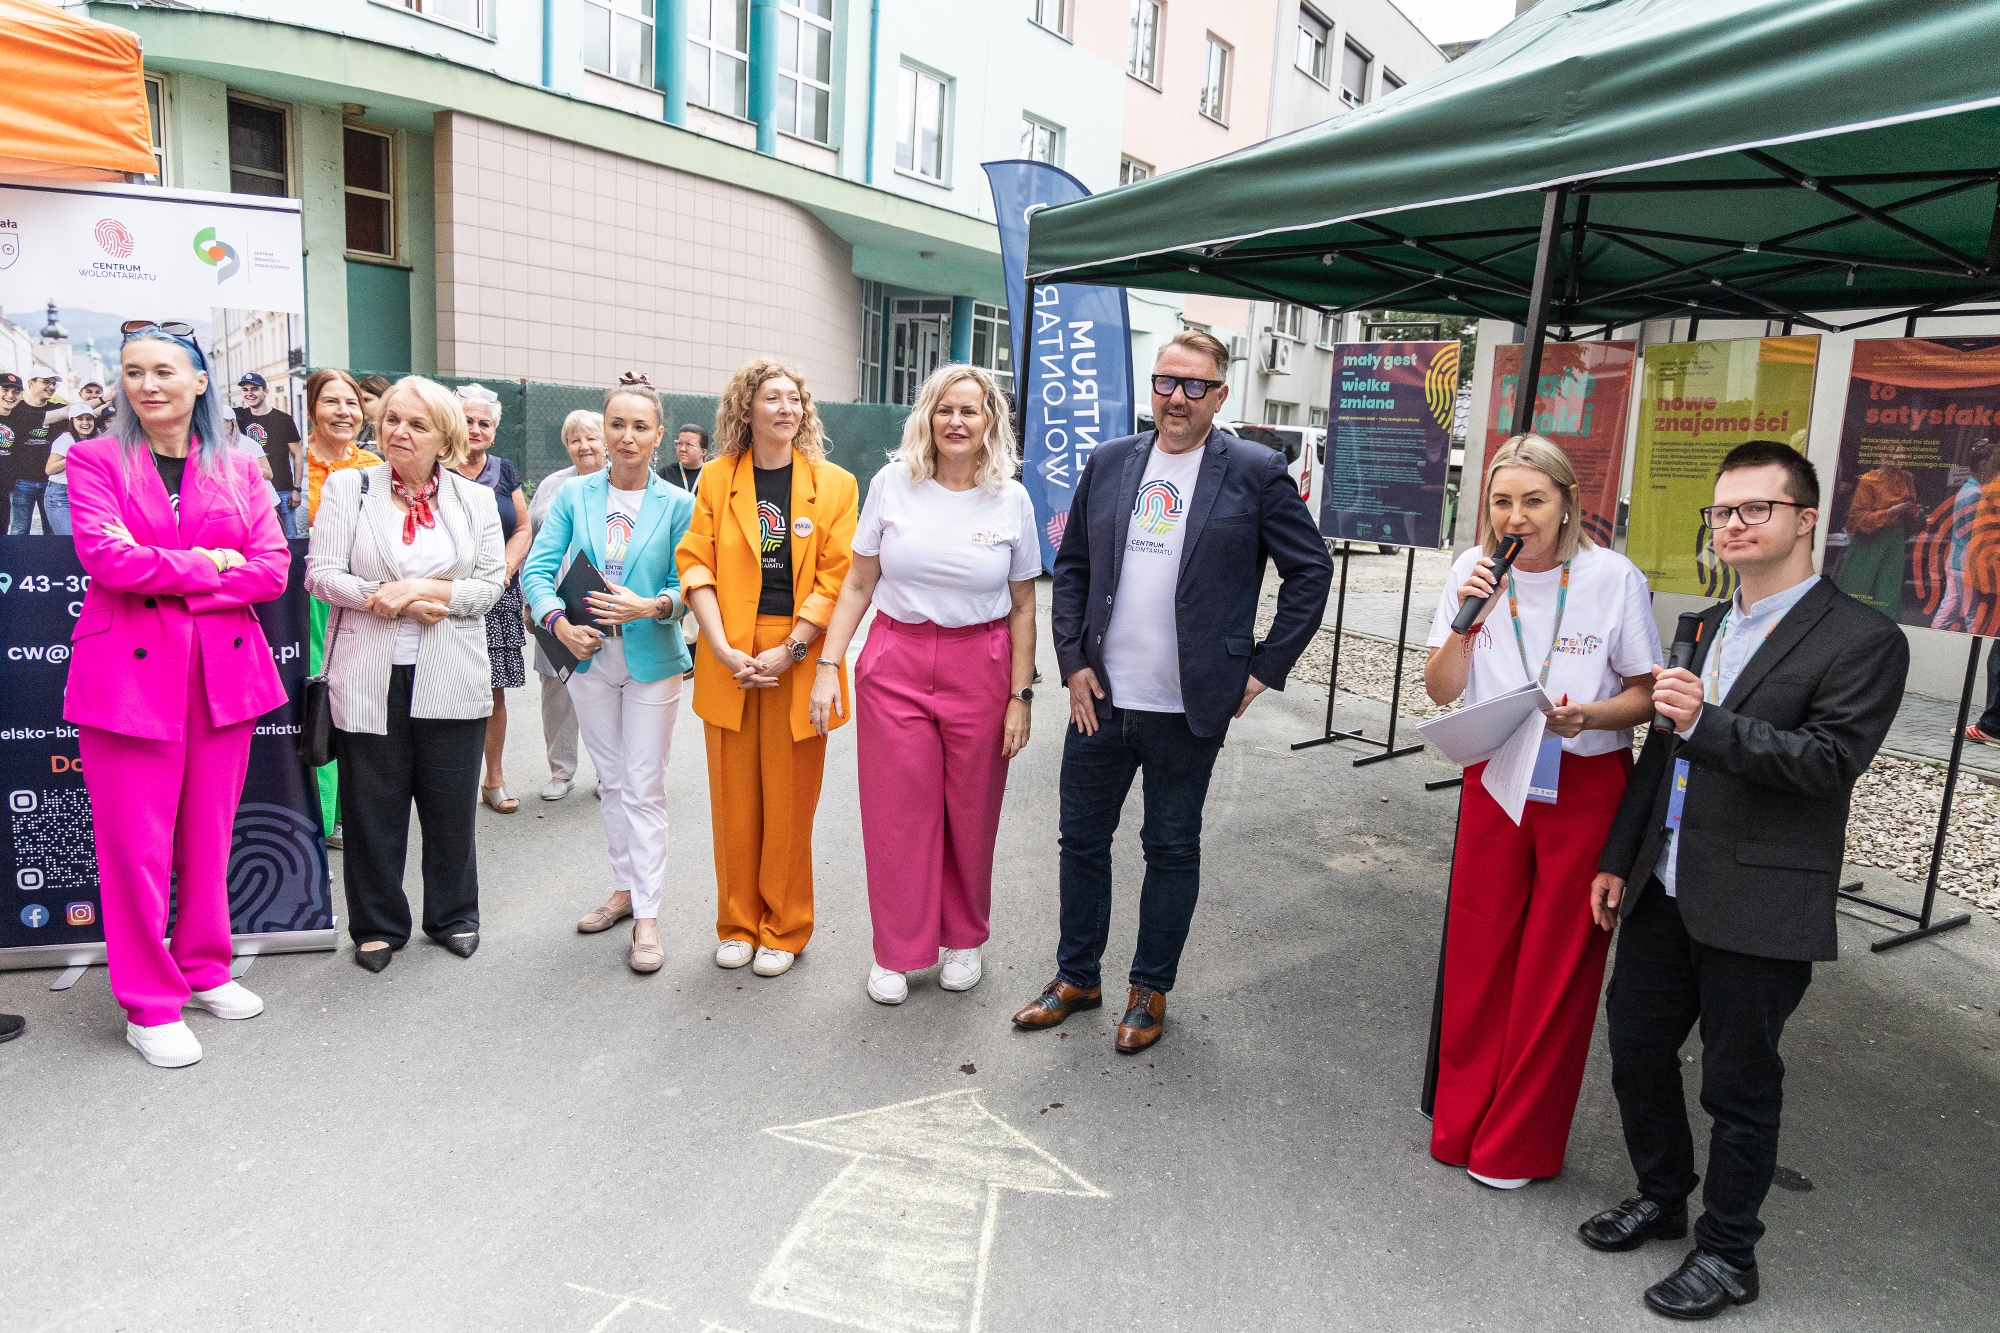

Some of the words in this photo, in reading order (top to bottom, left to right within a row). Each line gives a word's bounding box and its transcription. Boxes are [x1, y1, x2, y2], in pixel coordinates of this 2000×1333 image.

[92, 261, 141, 272] CENTRUM
[78, 268, 157, 281] WOLONTARIATU
[1343, 353, 1382, 370] mały
[1383, 353, 1418, 371] gest
[1341, 377, 1390, 392] wielka
[1869, 381, 1897, 400] to
[1339, 395, 1395, 409] zmiana
[1657, 396, 1717, 411] nowe
[1497, 402, 1594, 437] koki
[1654, 410, 1789, 438] znajomości
[1131, 540, 1165, 549] CENTRUM
[1561, 636, 1589, 646] TEATR
[7, 644, 74, 664] cw@
[1552, 646, 1586, 656] GRODZKI
